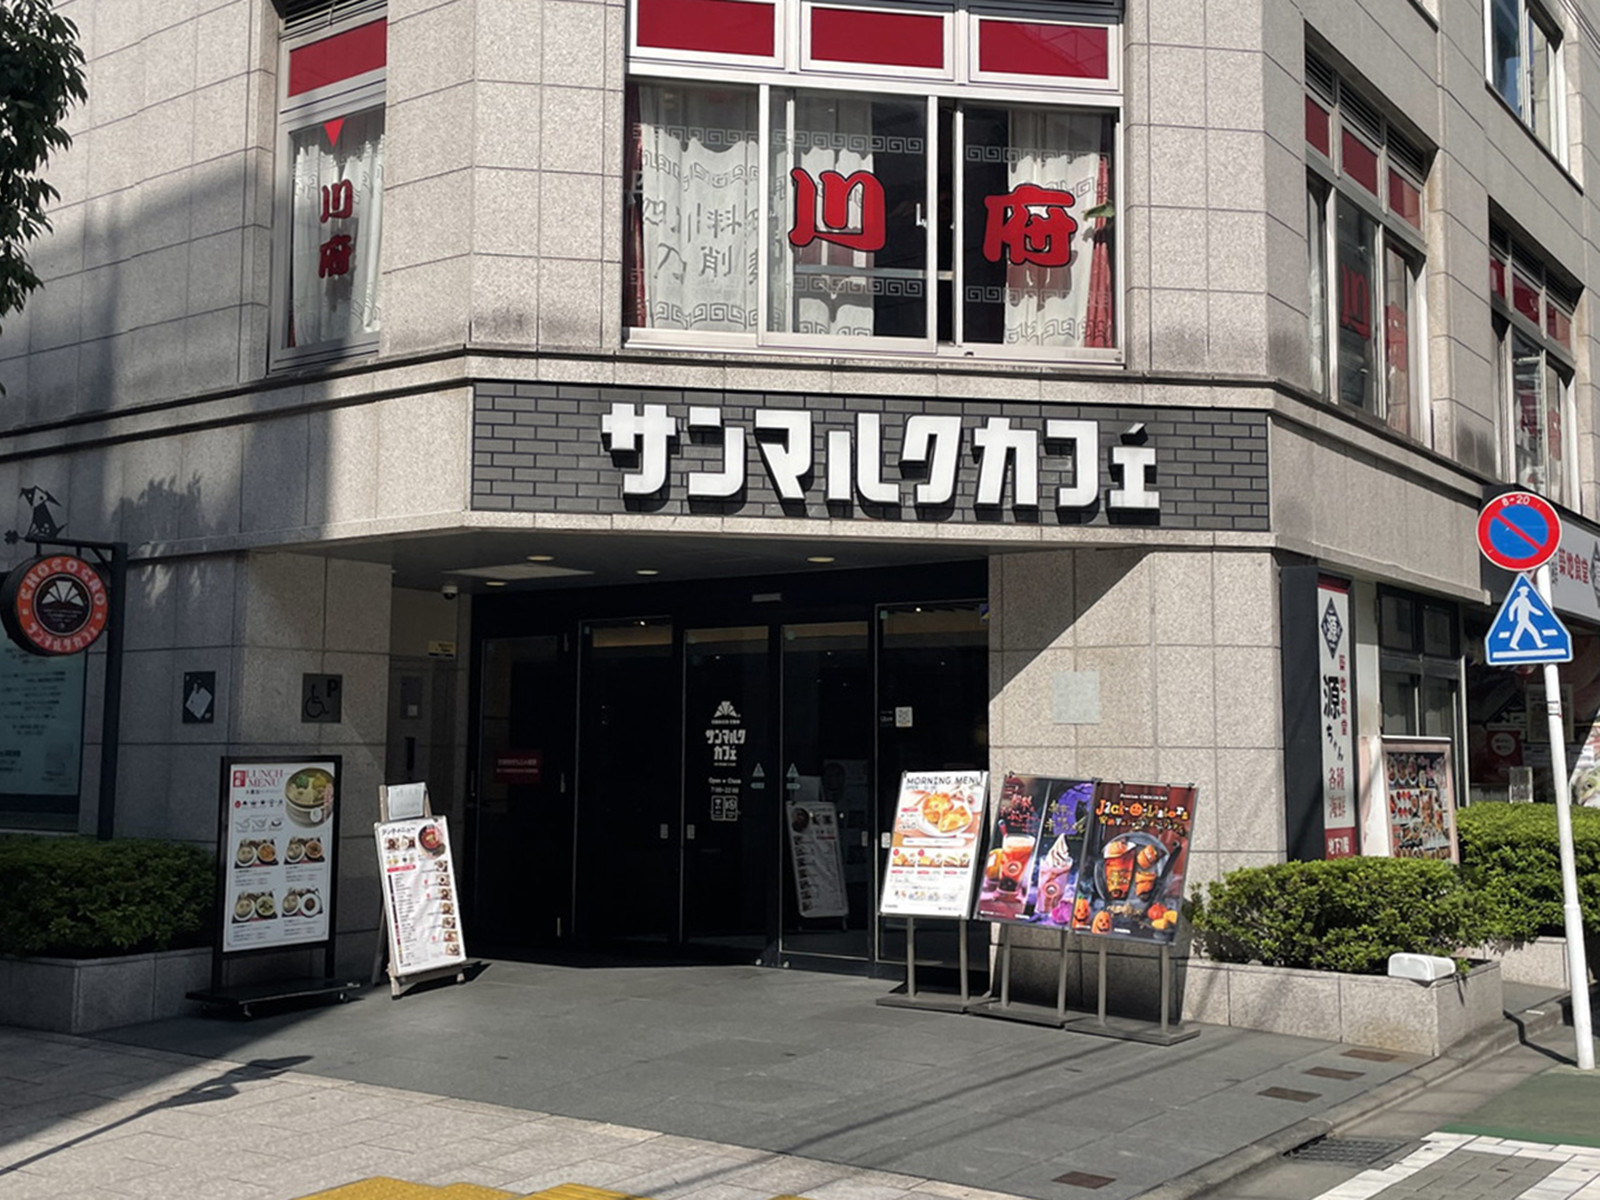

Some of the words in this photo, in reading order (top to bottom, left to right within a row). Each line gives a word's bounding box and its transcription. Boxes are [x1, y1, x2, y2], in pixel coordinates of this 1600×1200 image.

[601, 402, 1160, 510] サンマルクカフェ
[705, 729, 746, 744] サンマルク
[714, 745, 737, 760] カフェ
[906, 776, 952, 786] MORNING
[955, 776, 982, 785] MENU
